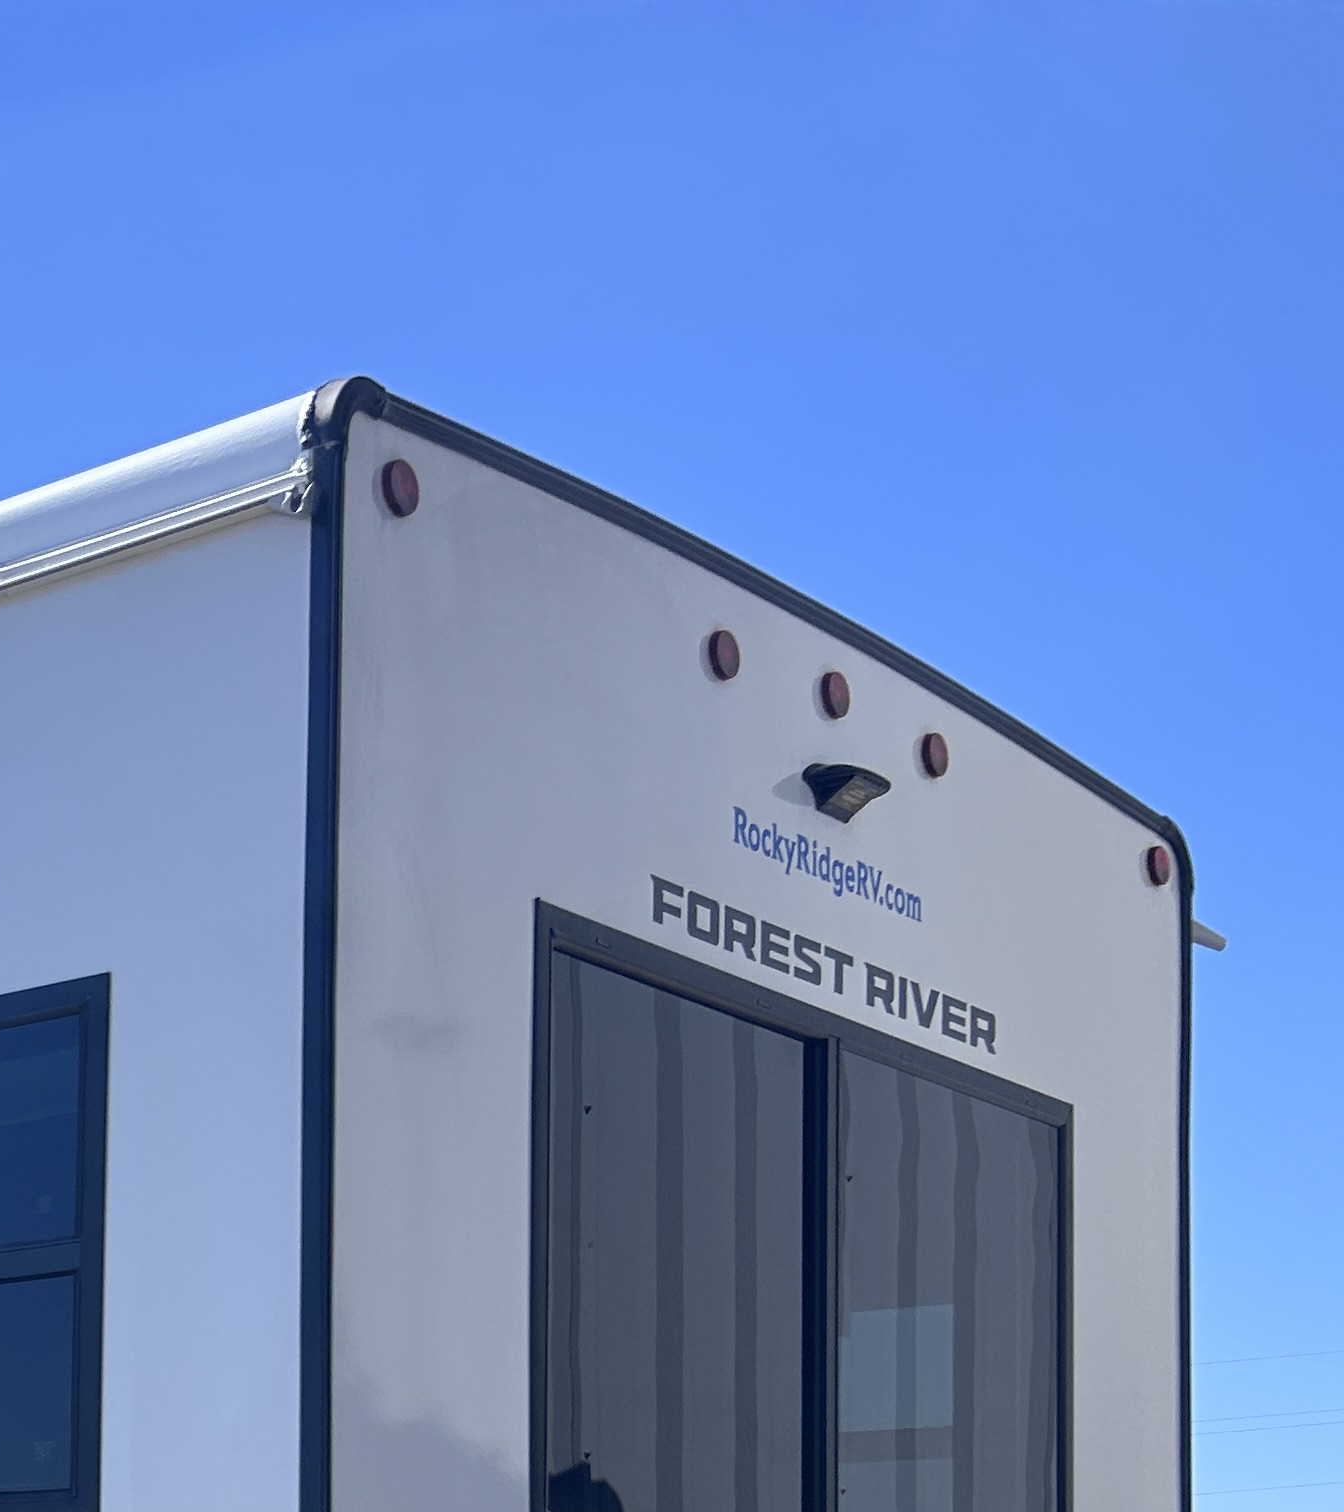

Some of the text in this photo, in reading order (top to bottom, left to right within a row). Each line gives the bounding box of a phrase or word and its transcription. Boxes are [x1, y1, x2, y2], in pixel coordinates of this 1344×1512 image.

[732, 806, 922, 922] RockyRidgeRV.com
[650, 874, 996, 1054] FOREST RIVER
